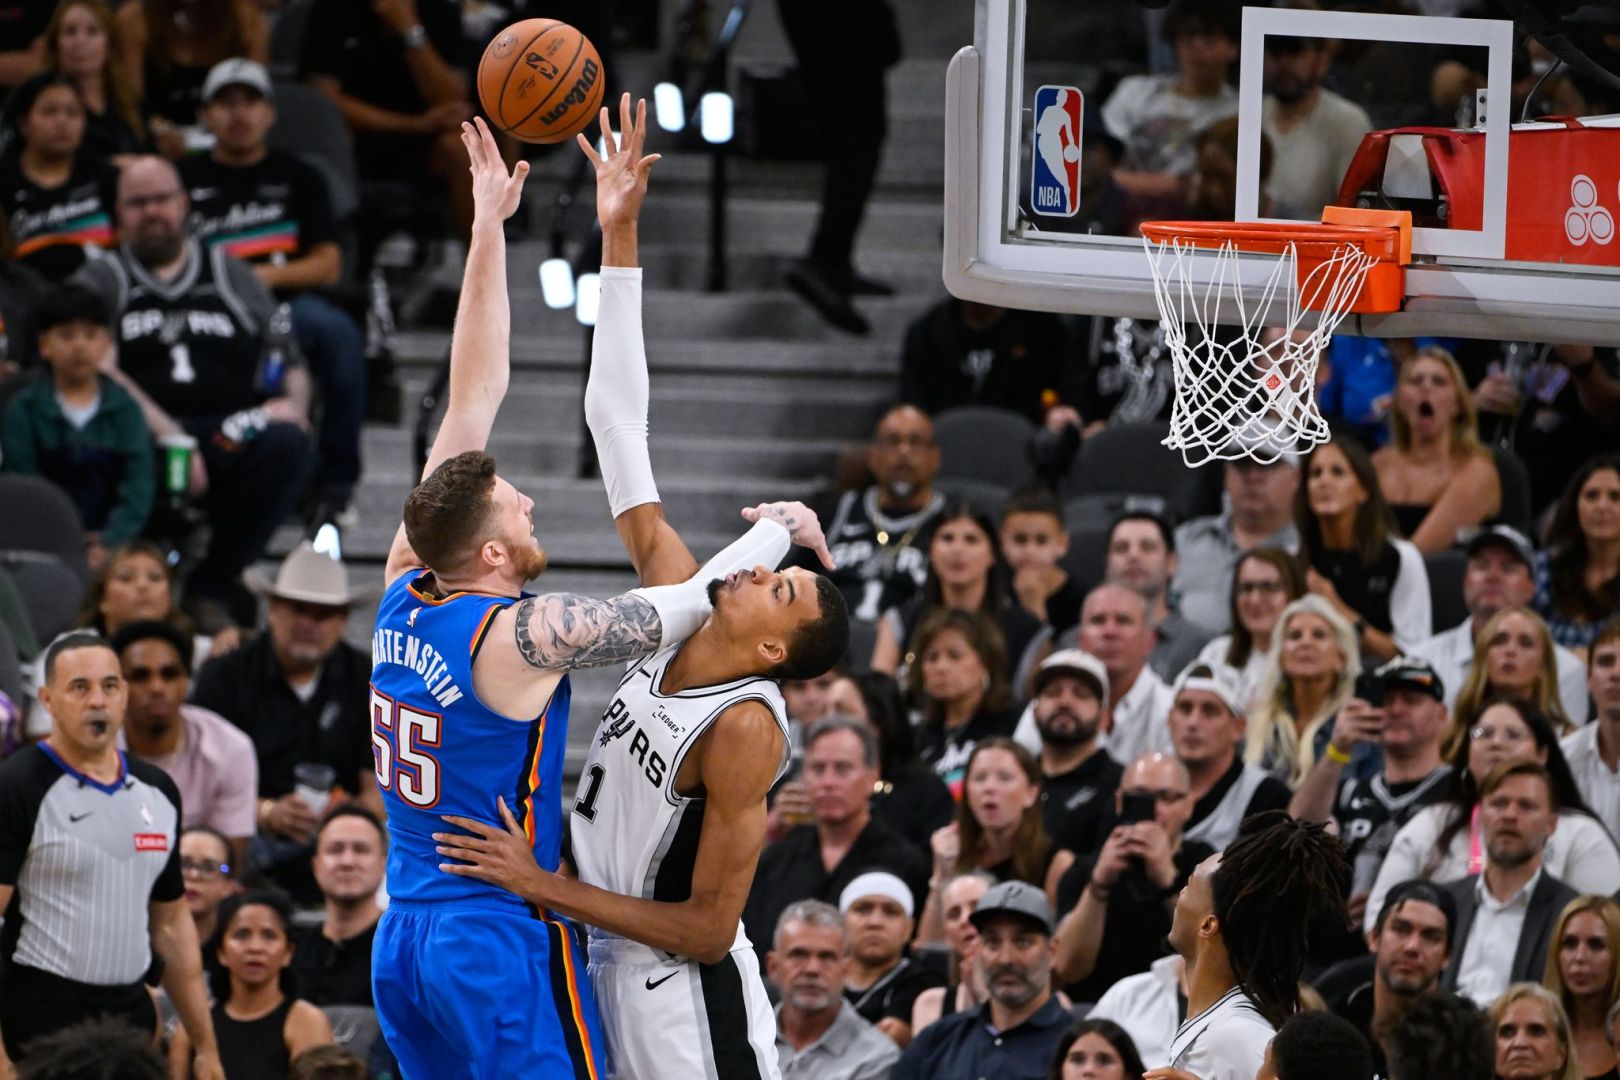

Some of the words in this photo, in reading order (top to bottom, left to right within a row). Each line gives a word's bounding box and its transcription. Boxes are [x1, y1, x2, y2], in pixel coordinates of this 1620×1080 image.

[539, 58, 598, 125] Wilson
[1038, 186, 1061, 207] NBA
[170, 344, 195, 383] 1
[855, 580, 882, 620] 1
[372, 628, 463, 708] ARTENSTEIN
[369, 682, 442, 810] 55
[600, 698, 667, 789] PURS
[656, 711, 681, 736] LEDGER
[571, 762, 606, 824] 1
